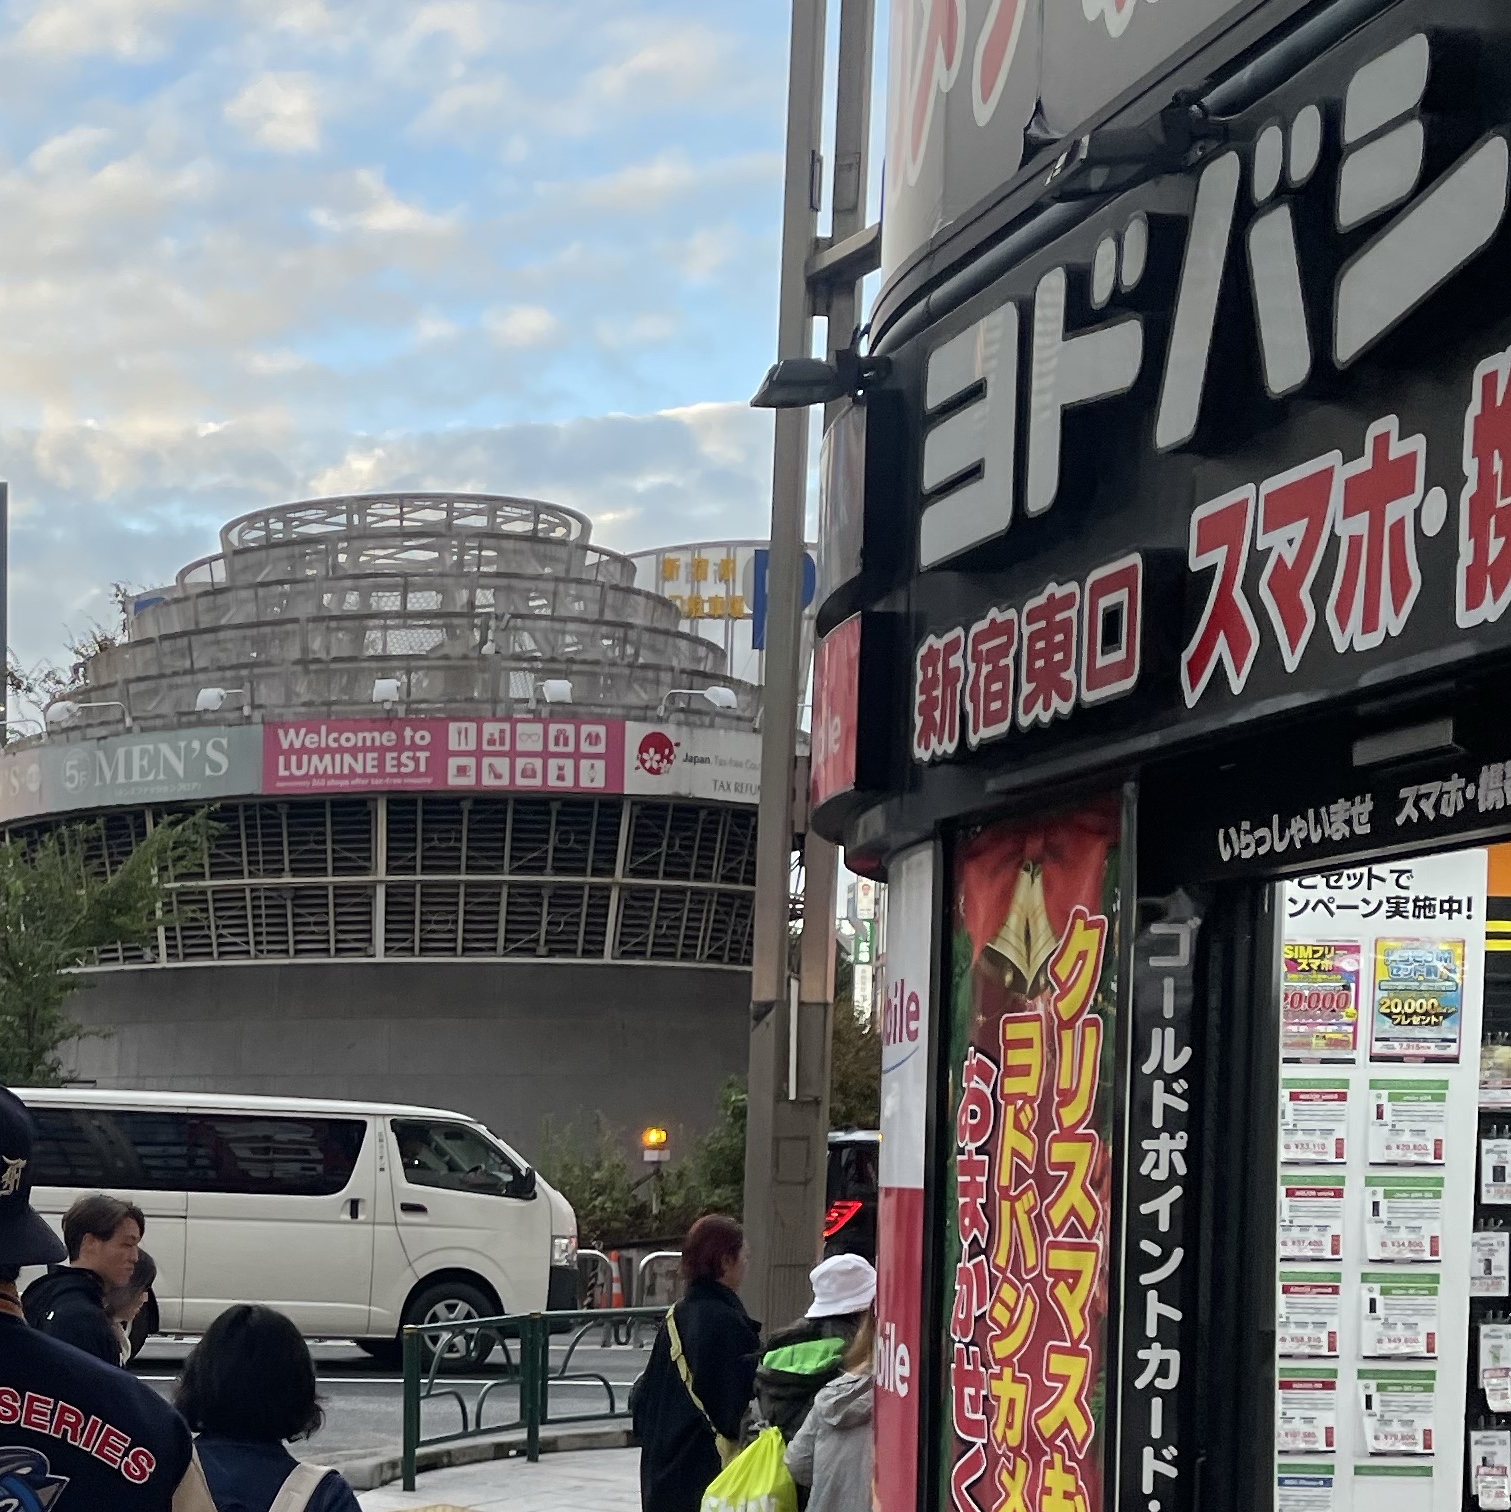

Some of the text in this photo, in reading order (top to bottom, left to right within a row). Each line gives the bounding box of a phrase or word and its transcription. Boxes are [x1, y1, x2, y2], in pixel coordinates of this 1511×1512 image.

[919, 32, 1509, 572] ヨドバシ
[912, 553, 1143, 762] 新宿東口
[278, 725, 431, 750] Welcome to
[94, 736, 229, 786] MEN'S
[278, 751, 431, 777] LUMINE EST
[682, 752, 711, 766] Japan
[712, 779, 732, 793] TAX
[1218, 793, 1374, 862] いらっしゃいませ
